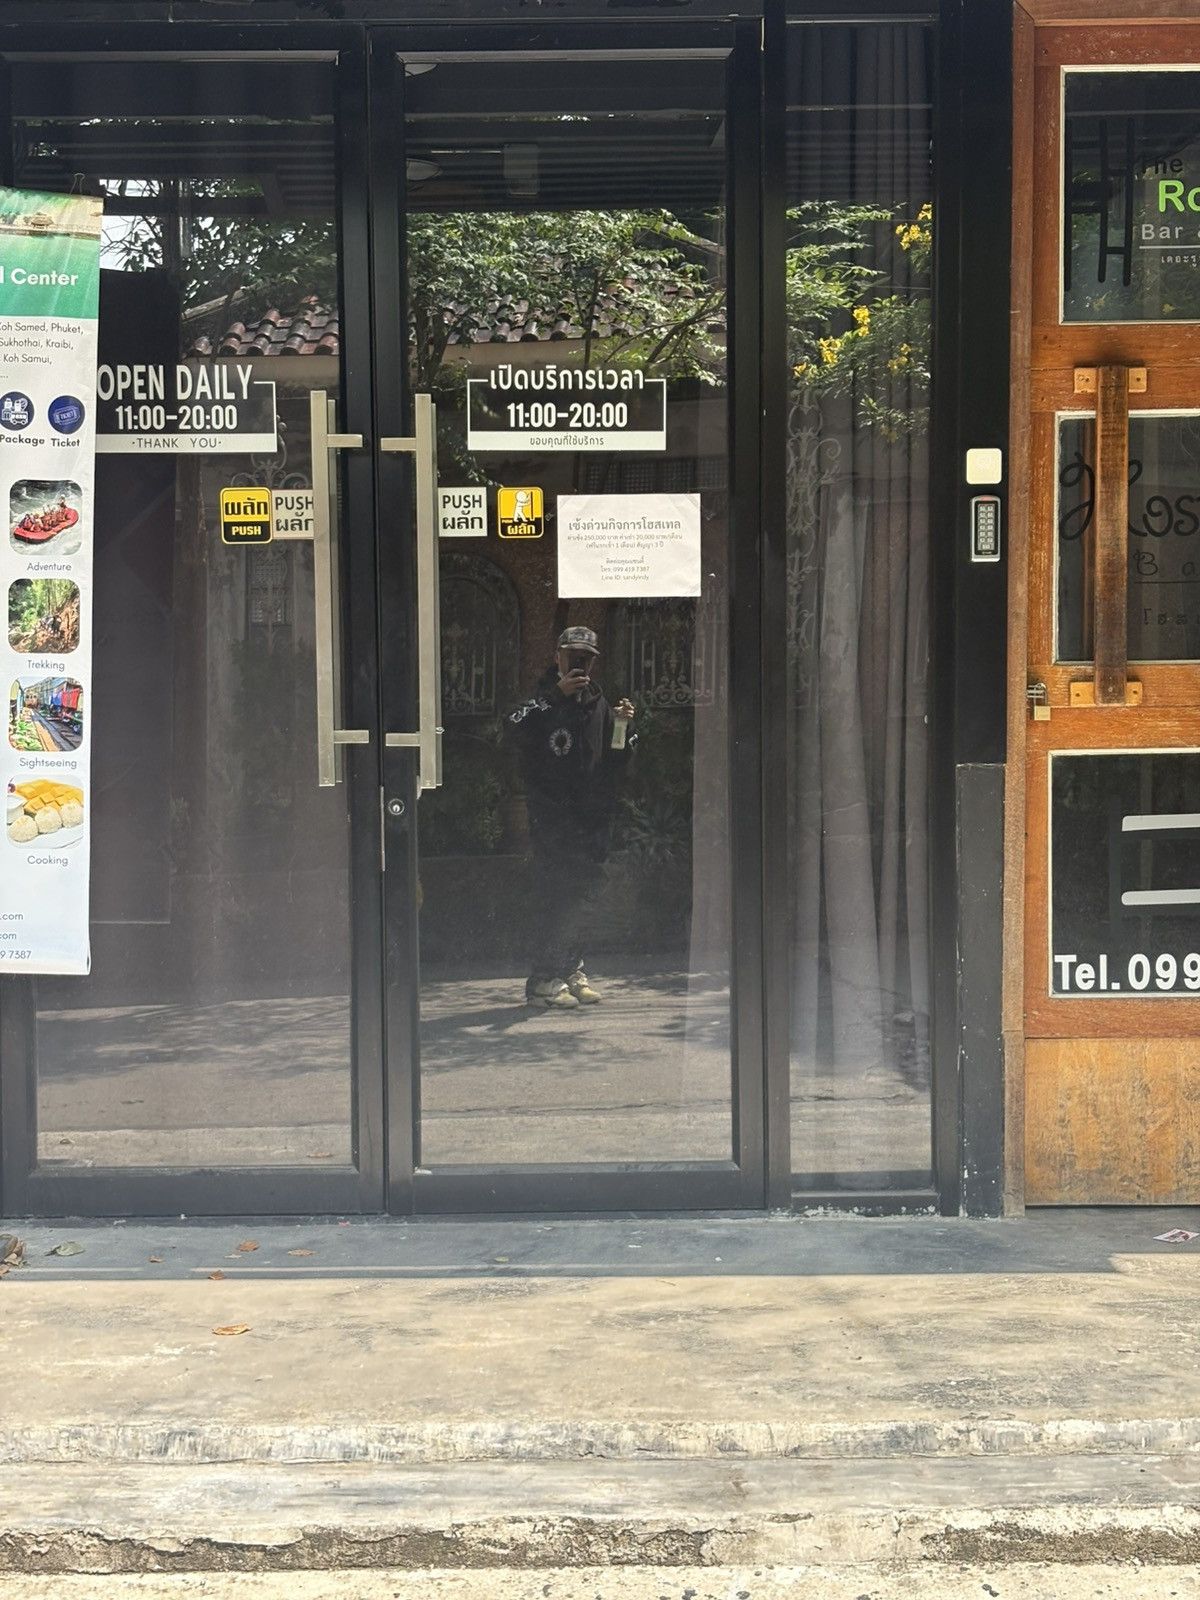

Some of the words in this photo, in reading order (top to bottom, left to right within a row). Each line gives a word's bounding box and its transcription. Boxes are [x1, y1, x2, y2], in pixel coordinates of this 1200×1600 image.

[1141, 223, 1184, 240] Bar
[10, 267, 79, 286] Center
[0, 321, 12, 331] oh
[15, 322, 48, 333] Samed,
[51, 322, 84, 335] Phuket,
[0, 337, 43, 348] Sukhothai,
[46, 338, 74, 350] Kraibi,
[3, 353, 19, 363] Koh
[21, 353, 52, 364] Samui,
[97, 364, 165, 401] OPEN
[176, 364, 253, 400] DAILY
[490, 364, 644, 390] เปิดบริการเวลา
[0, 434, 45, 447] Package
[51, 438, 80, 447] Ticket
[529, 434, 605, 448] ขอบคุณที่ใช้บริการ
[224, 497, 268, 515] ผลัก
[275, 496, 314, 510] PUSH
[442, 494, 482, 508] PUSH
[442, 510, 483, 530] ผลัก
[569, 516, 681, 531] เซ้งด่วนกิจการโฮสเทล
[231, 525, 262, 536] PUSH
[507, 523, 536, 535] ผลัก
[27, 562, 72, 571] Adventure
[27, 660, 65, 672] Trekking
[19, 757, 77, 769] Sightseeing
[27, 855, 68, 866] Cooking
